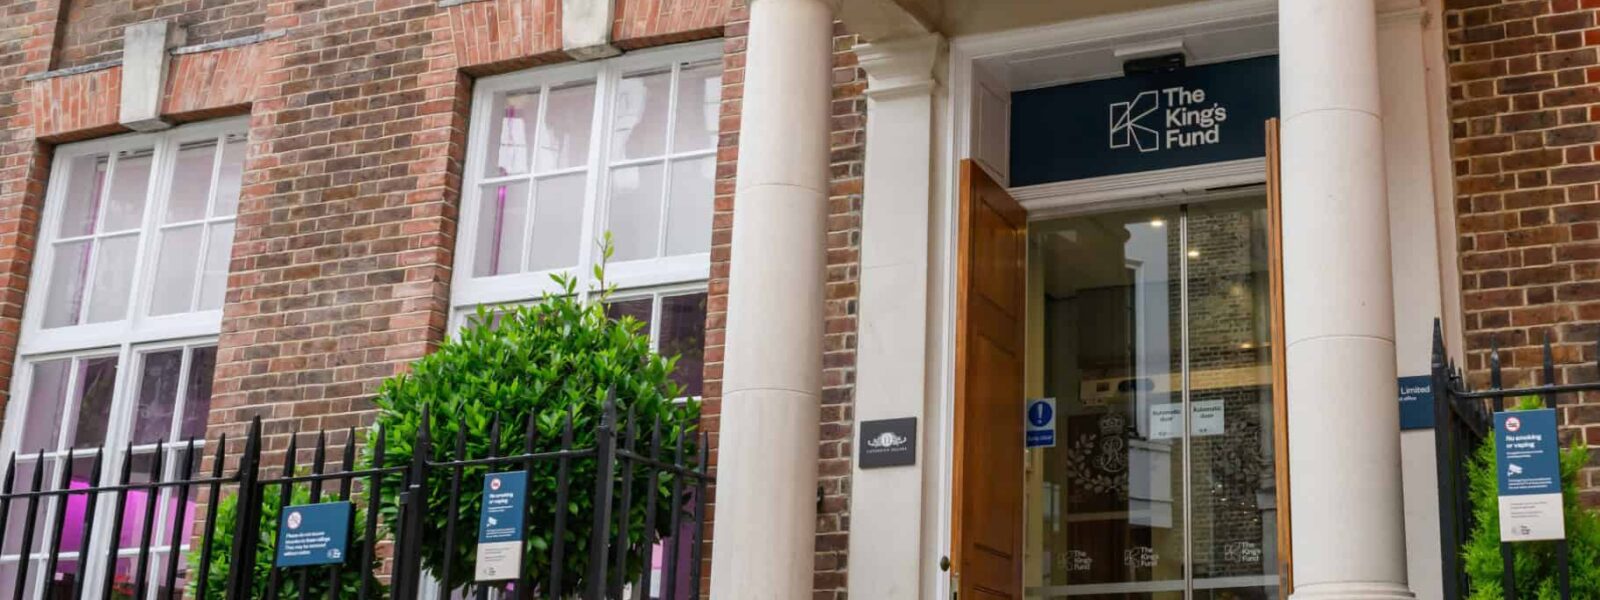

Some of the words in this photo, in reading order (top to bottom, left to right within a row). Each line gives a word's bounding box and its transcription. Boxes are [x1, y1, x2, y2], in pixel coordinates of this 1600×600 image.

[1162, 86, 1205, 107] The
[1165, 102, 1227, 128] King's
[1166, 124, 1220, 149] Fund
[1400, 385, 1431, 394] Limited
